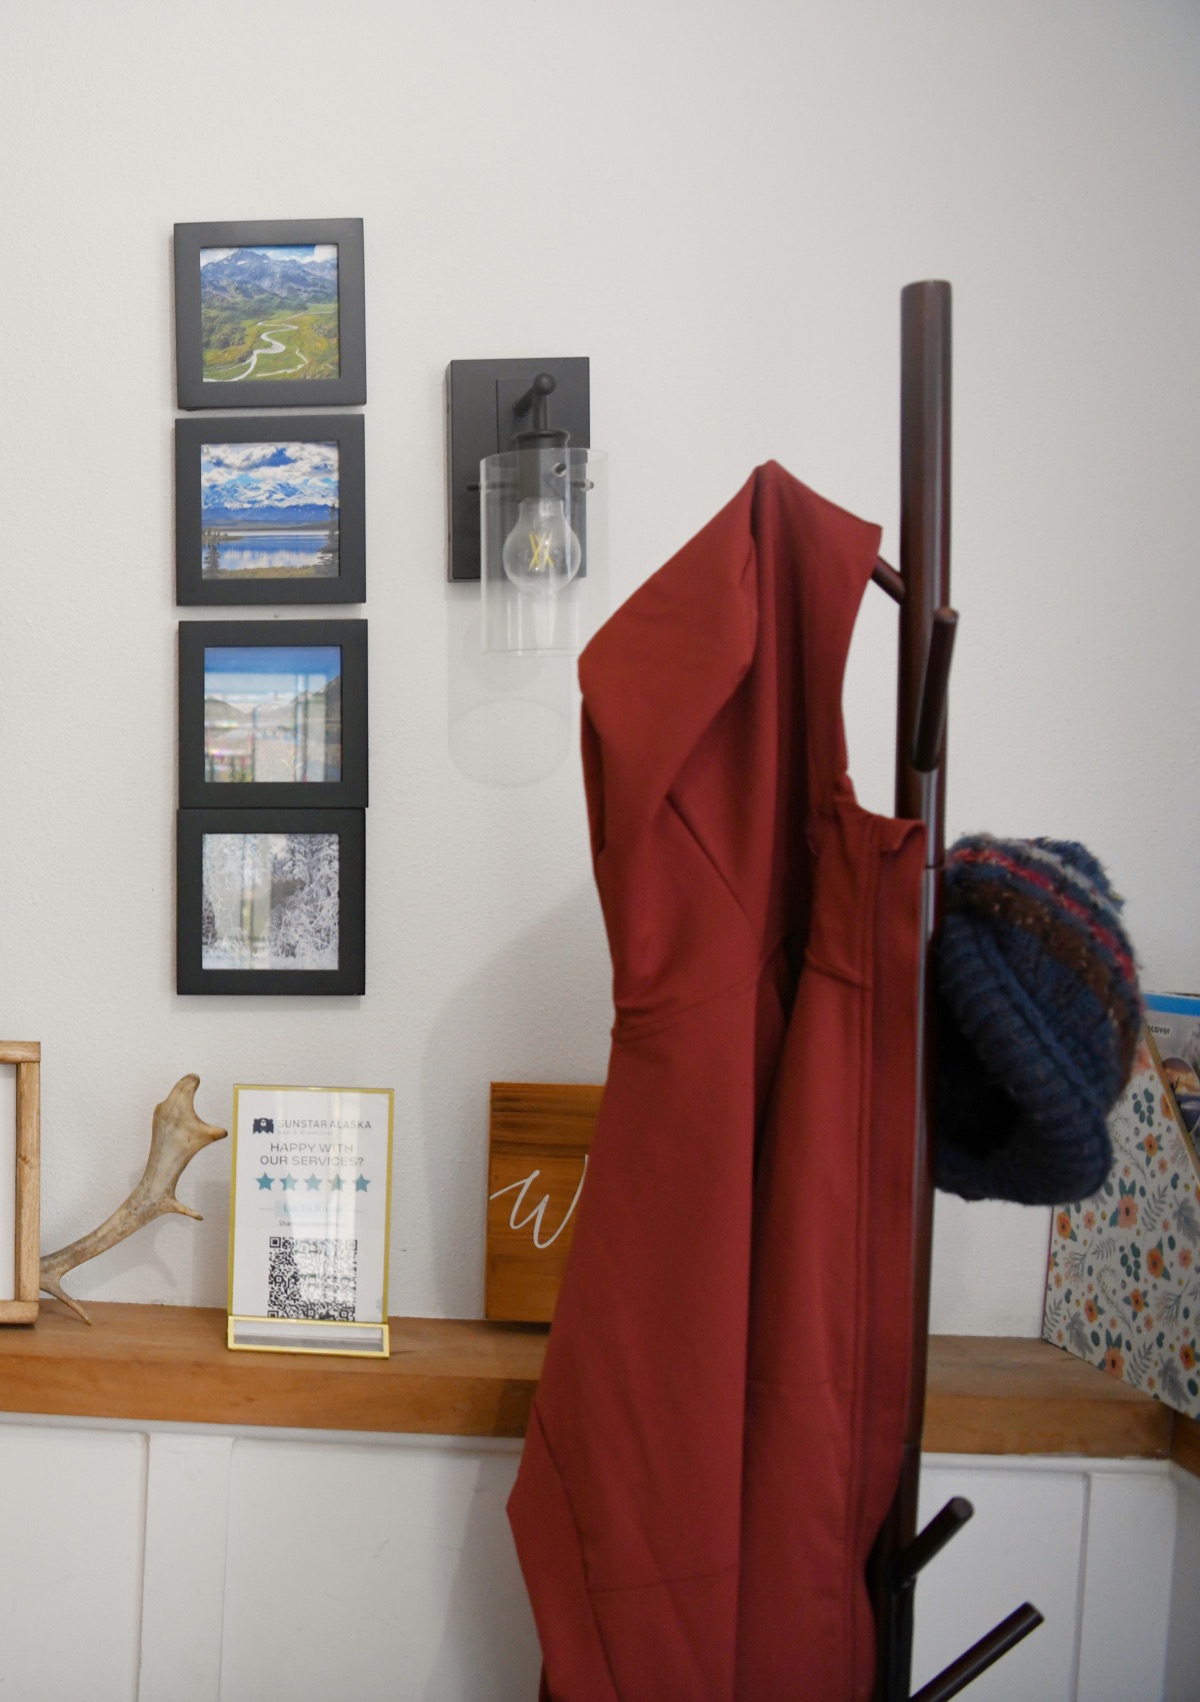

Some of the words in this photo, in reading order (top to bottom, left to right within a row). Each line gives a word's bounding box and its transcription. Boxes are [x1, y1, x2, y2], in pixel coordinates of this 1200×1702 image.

[278, 1119, 327, 1129] SUNSTAR
[329, 1120, 371, 1129] ALASKA
[270, 1143, 316, 1153] HAPPY
[318, 1143, 354, 1153] WITH
[260, 1155, 288, 1165] OUR
[291, 1156, 364, 1167] SERVICES?
